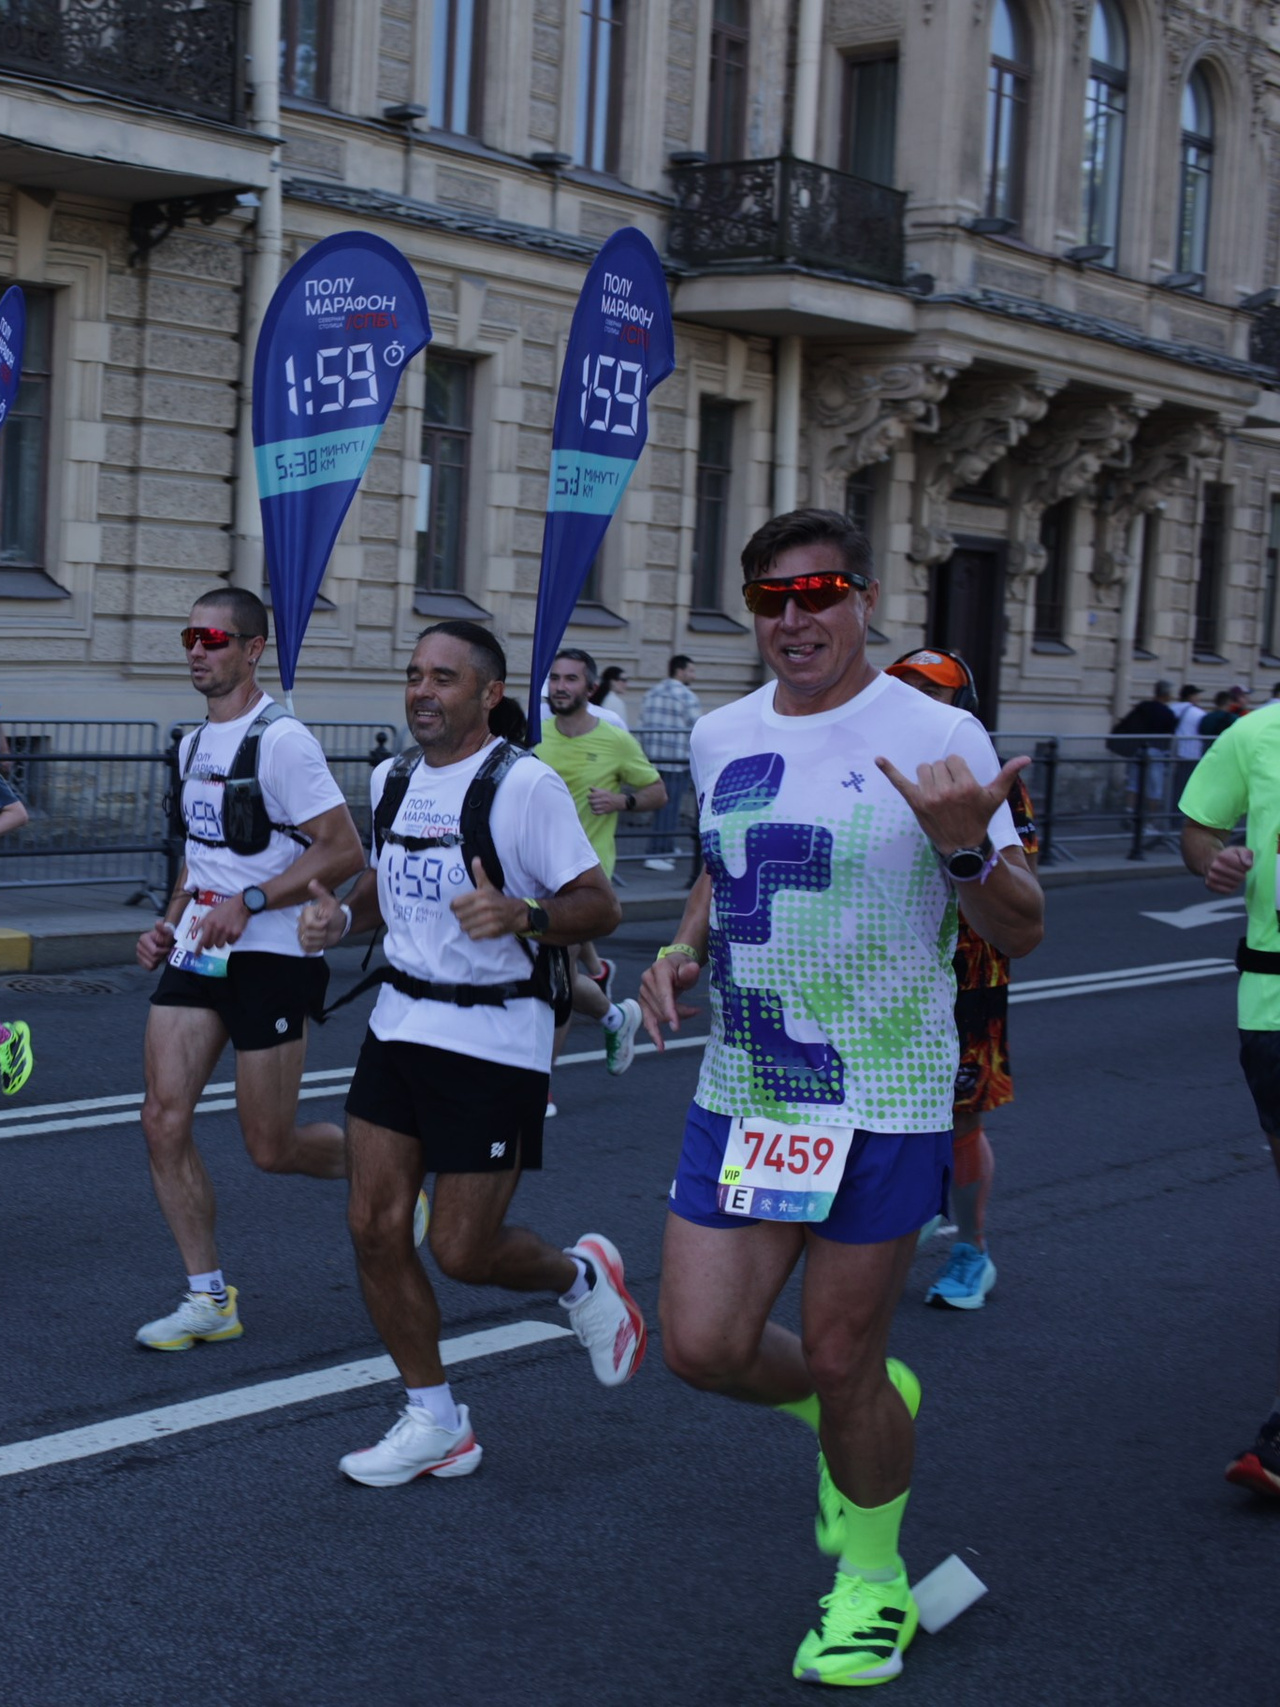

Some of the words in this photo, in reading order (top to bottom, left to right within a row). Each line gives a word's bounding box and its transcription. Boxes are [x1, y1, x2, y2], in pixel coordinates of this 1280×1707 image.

[305, 277, 355, 297] ПОЛУ
[603, 272, 633, 298] ПОЛУ
[306, 295, 396, 316] МАРАФОН
[601, 294, 654, 330] МАРАФОН
[285, 342, 379, 416] 1:59
[276, 449, 318, 480] 5:38
[320, 458, 336, 472] КМ
[583, 484, 593, 498] КМ
[196, 752, 212, 762] ОЛУ
[406, 799, 436, 810] ПОЛУ
[402, 811, 460, 826] МАРАФОН
[388, 855, 443, 902] 1:59
[174, 951, 183, 964] E
[744, 1131, 834, 1175] 7459
[724, 1169, 740, 1181] VIP
[732, 1189, 748, 1209] E
